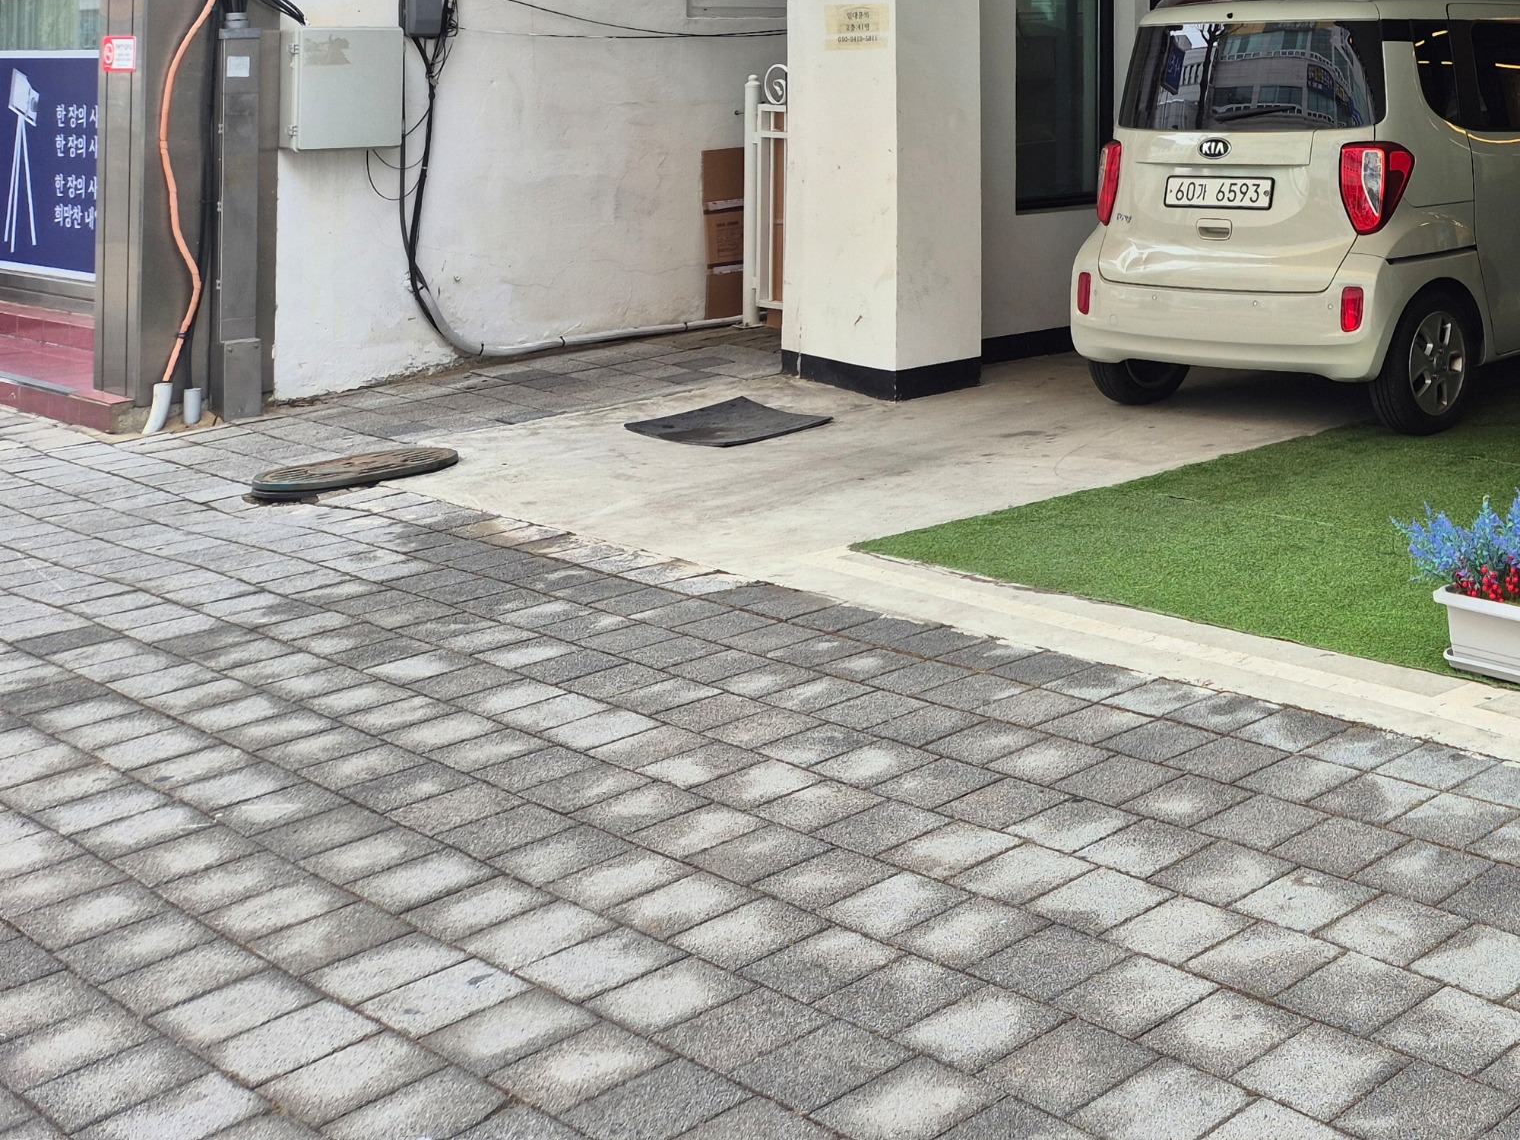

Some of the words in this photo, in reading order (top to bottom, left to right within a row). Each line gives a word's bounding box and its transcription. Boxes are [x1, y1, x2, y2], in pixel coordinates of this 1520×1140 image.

[56, 104, 66, 128] 한
[68, 104, 86, 129] 장의
[55, 134, 65, 158] 한
[68, 134, 86, 158] 장의
[1202, 142, 1225, 154] KIA
[54, 173, 65, 197] 한
[66, 174, 86, 198] 장의
[1175, 181, 1207, 202] 60가
[1215, 182, 1261, 203] 6593
[54, 204, 83, 229] 희망찬
[84, 205, 97, 230] 내
